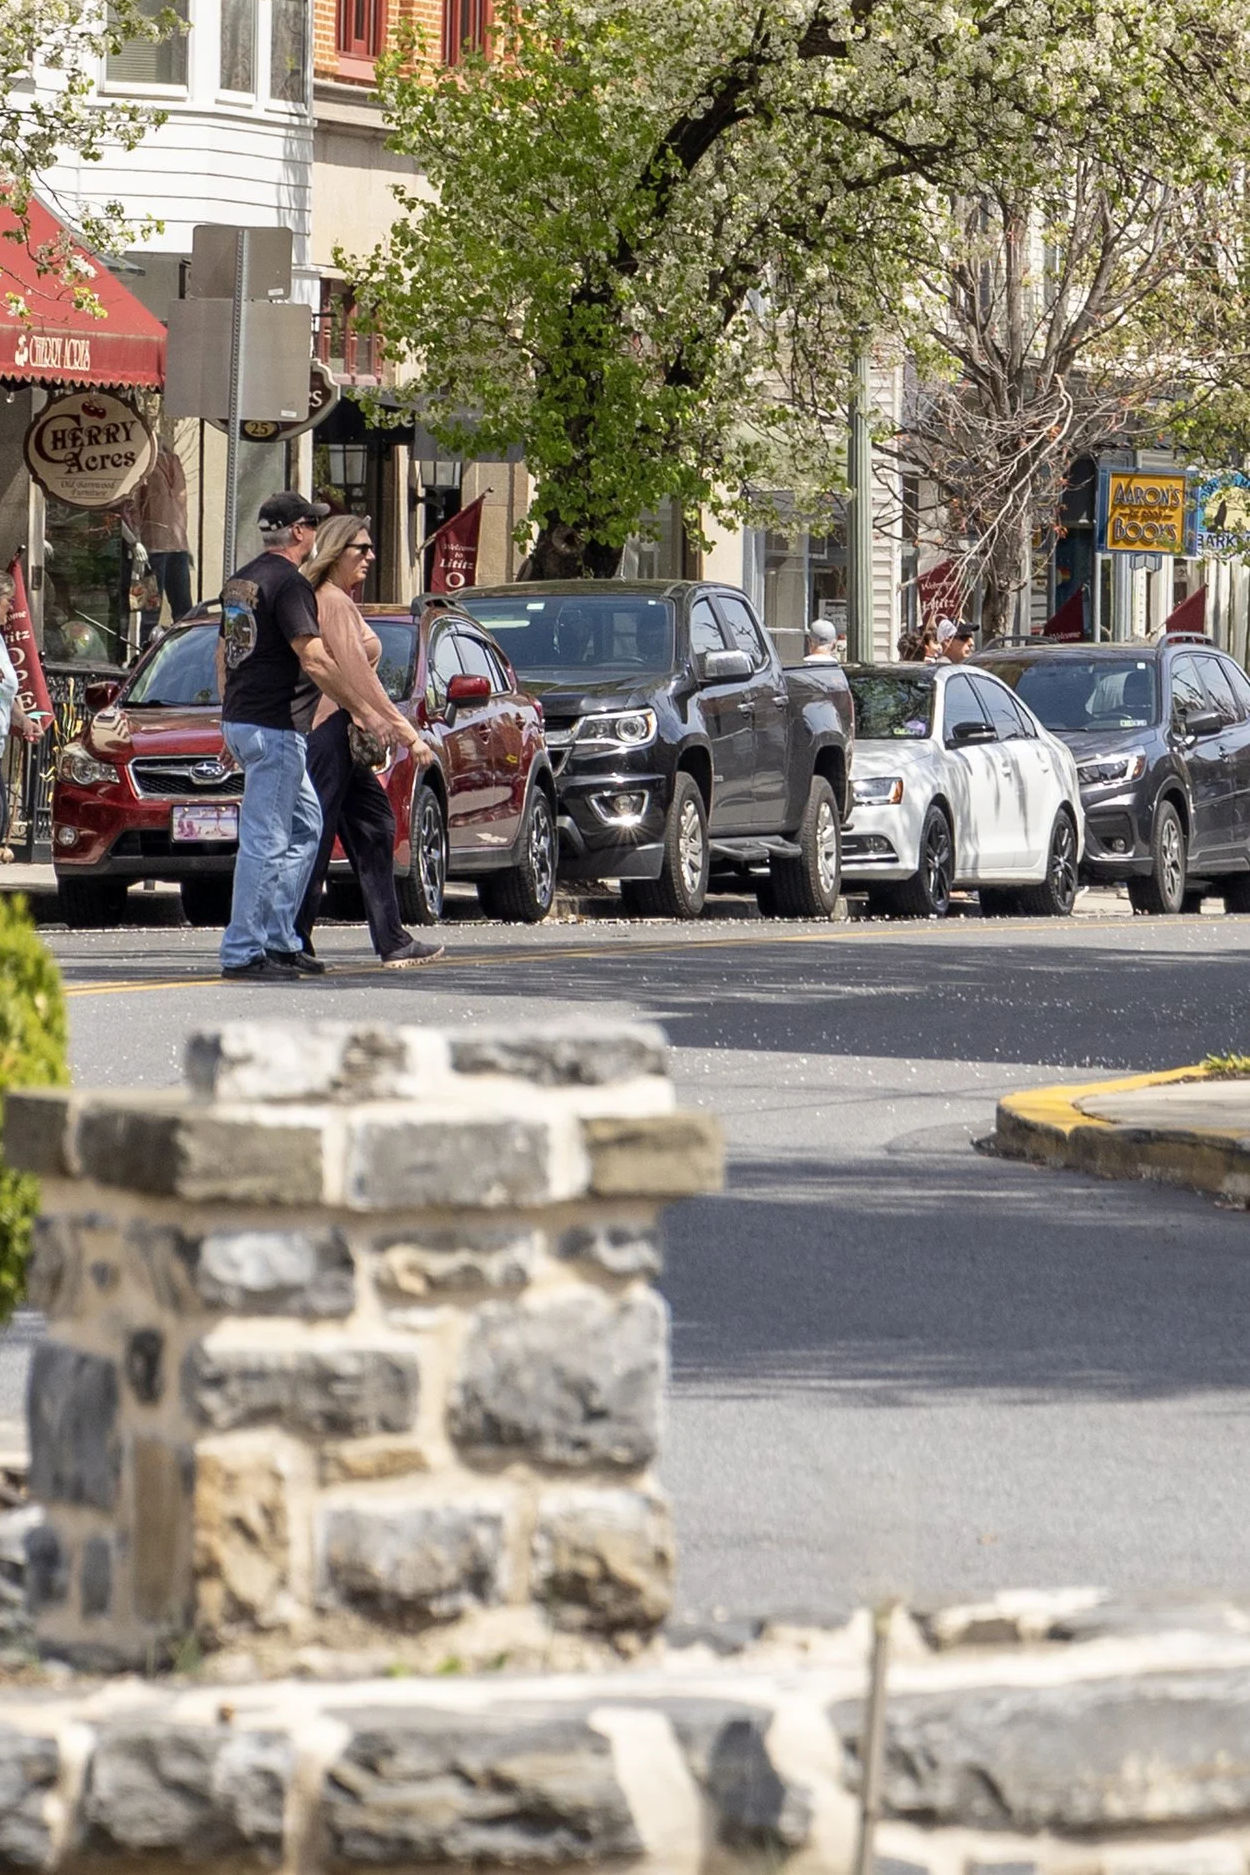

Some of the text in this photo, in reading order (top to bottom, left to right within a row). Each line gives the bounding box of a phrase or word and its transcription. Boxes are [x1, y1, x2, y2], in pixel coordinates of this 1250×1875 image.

[251, 422, 268, 435] 25
[1114, 482, 1181, 506] AARON'S
[439, 558, 474, 570] Lititz
